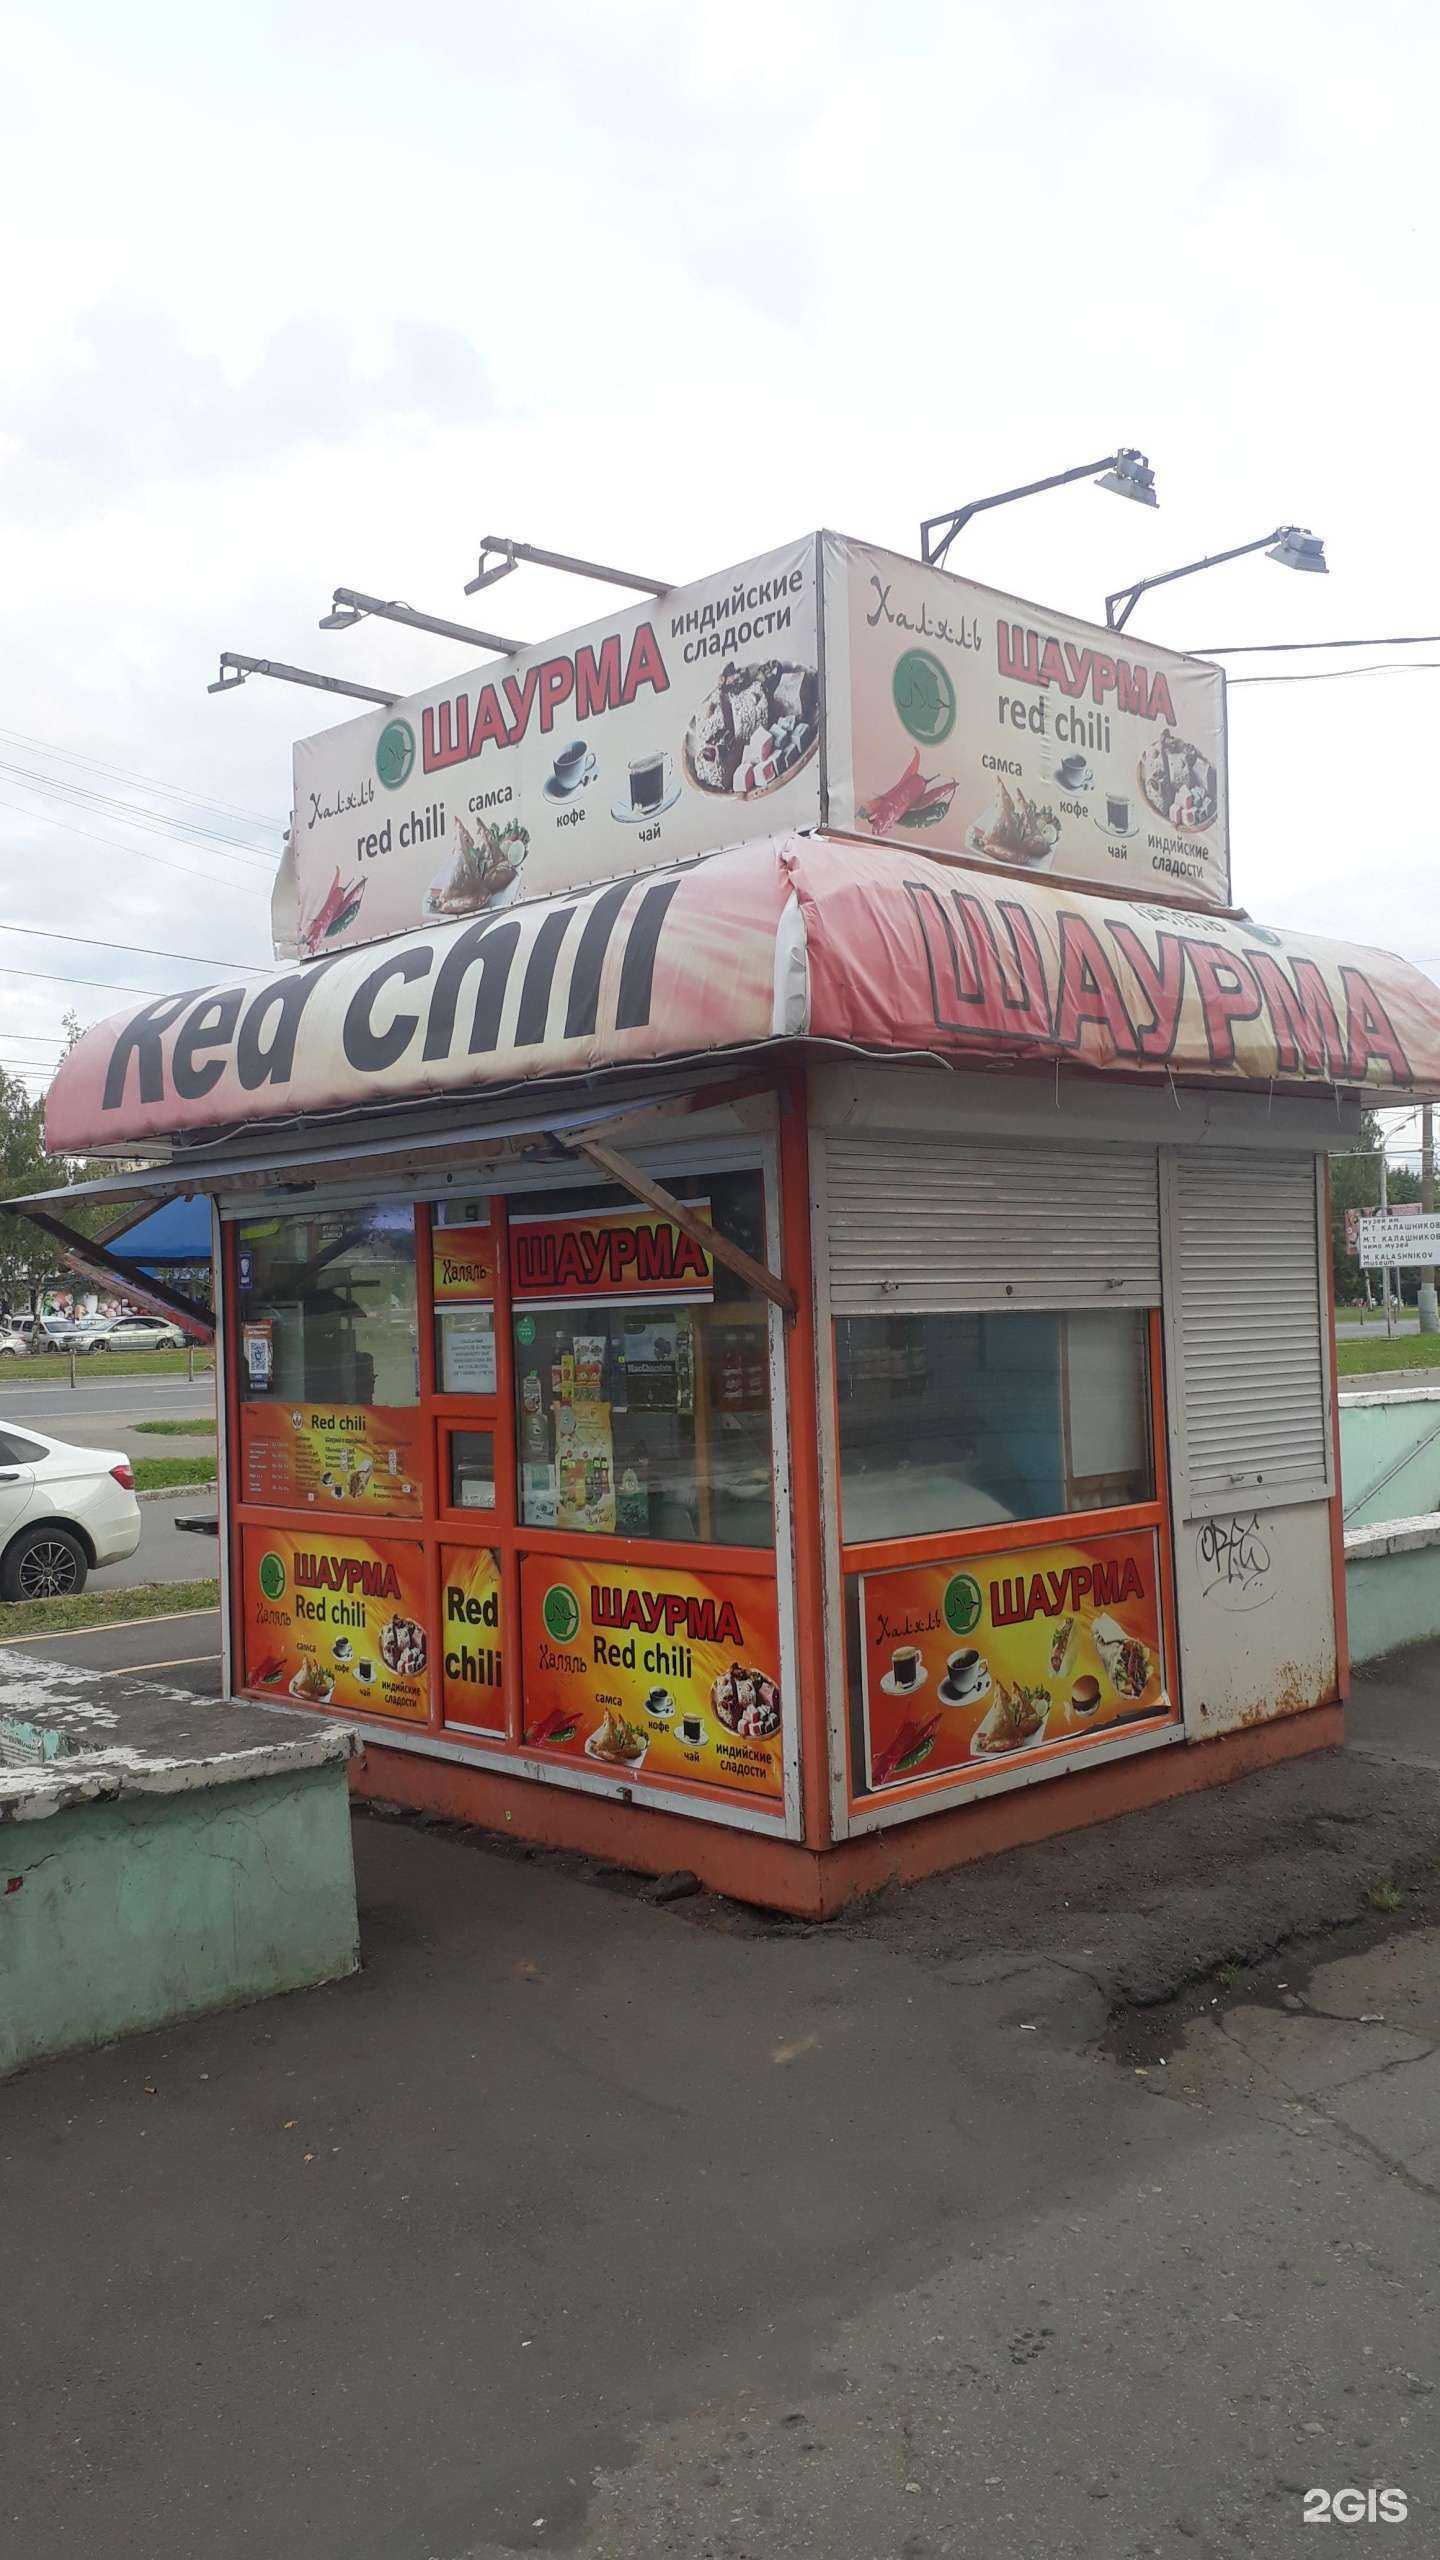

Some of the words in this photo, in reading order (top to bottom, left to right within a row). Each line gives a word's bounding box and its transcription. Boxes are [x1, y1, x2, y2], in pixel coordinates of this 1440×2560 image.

[671, 570, 802, 638] индийские
[683, 606, 792, 664] сладости
[998, 619, 1176, 726] ШАУРМА
[422, 622, 670, 774] ШАУРМА
[998, 692, 1046, 736] red
[1054, 706, 1111, 753] chili
[981, 752, 1023, 777] самса
[468, 784, 513, 813] самса
[1059, 800, 1089, 820] кофе
[556, 807, 586, 828] кофе
[356, 819, 392, 861] red
[399, 803, 446, 849] chili
[638, 822, 662, 842] чай
[1108, 843, 1128, 862] чай
[1147, 833, 1210, 861] индийские
[1152, 853, 1204, 880] сладости
[102, 955, 341, 1110] Red
[343, 866, 702, 1072] chili
[904, 881, 1413, 1083] ШАУРМА
[517, 1223, 710, 1287] ШАУРМА
[1374, 1251, 1433, 1260] KALASHNIKOV
[443, 1259, 487, 1284] Халяль
[311, 1415, 335, 1430] Red
[339, 1415, 366, 1431] chili
[293, 1552, 402, 1600] ШАУРМА
[990, 1557, 1145, 1628] ШАУРМА
[256, 1602, 292, 1627] Халяль
[296, 1595, 326, 1622] Red
[331, 1599, 366, 1628] chili
[447, 1586, 499, 1628] Red
[590, 1584, 744, 1646] ШАУРМА
[296, 1642, 316, 1653] самса
[538, 1643, 587, 1673] Халяль
[593, 1636, 636, 1670] Red
[643, 1643, 692, 1679] chili
[334, 1663, 350, 1674] кофе
[445, 1645, 502, 1687] chili
[382, 1680, 422, 1697] индийские
[384, 1693, 417, 1708] сладости
[595, 1692, 622, 1707] самса
[648, 1718, 670, 1734] кофе
[683, 1750, 700, 1763] чай
[715, 1743, 773, 1765] индийские
[720, 1759, 767, 1779] сладости
